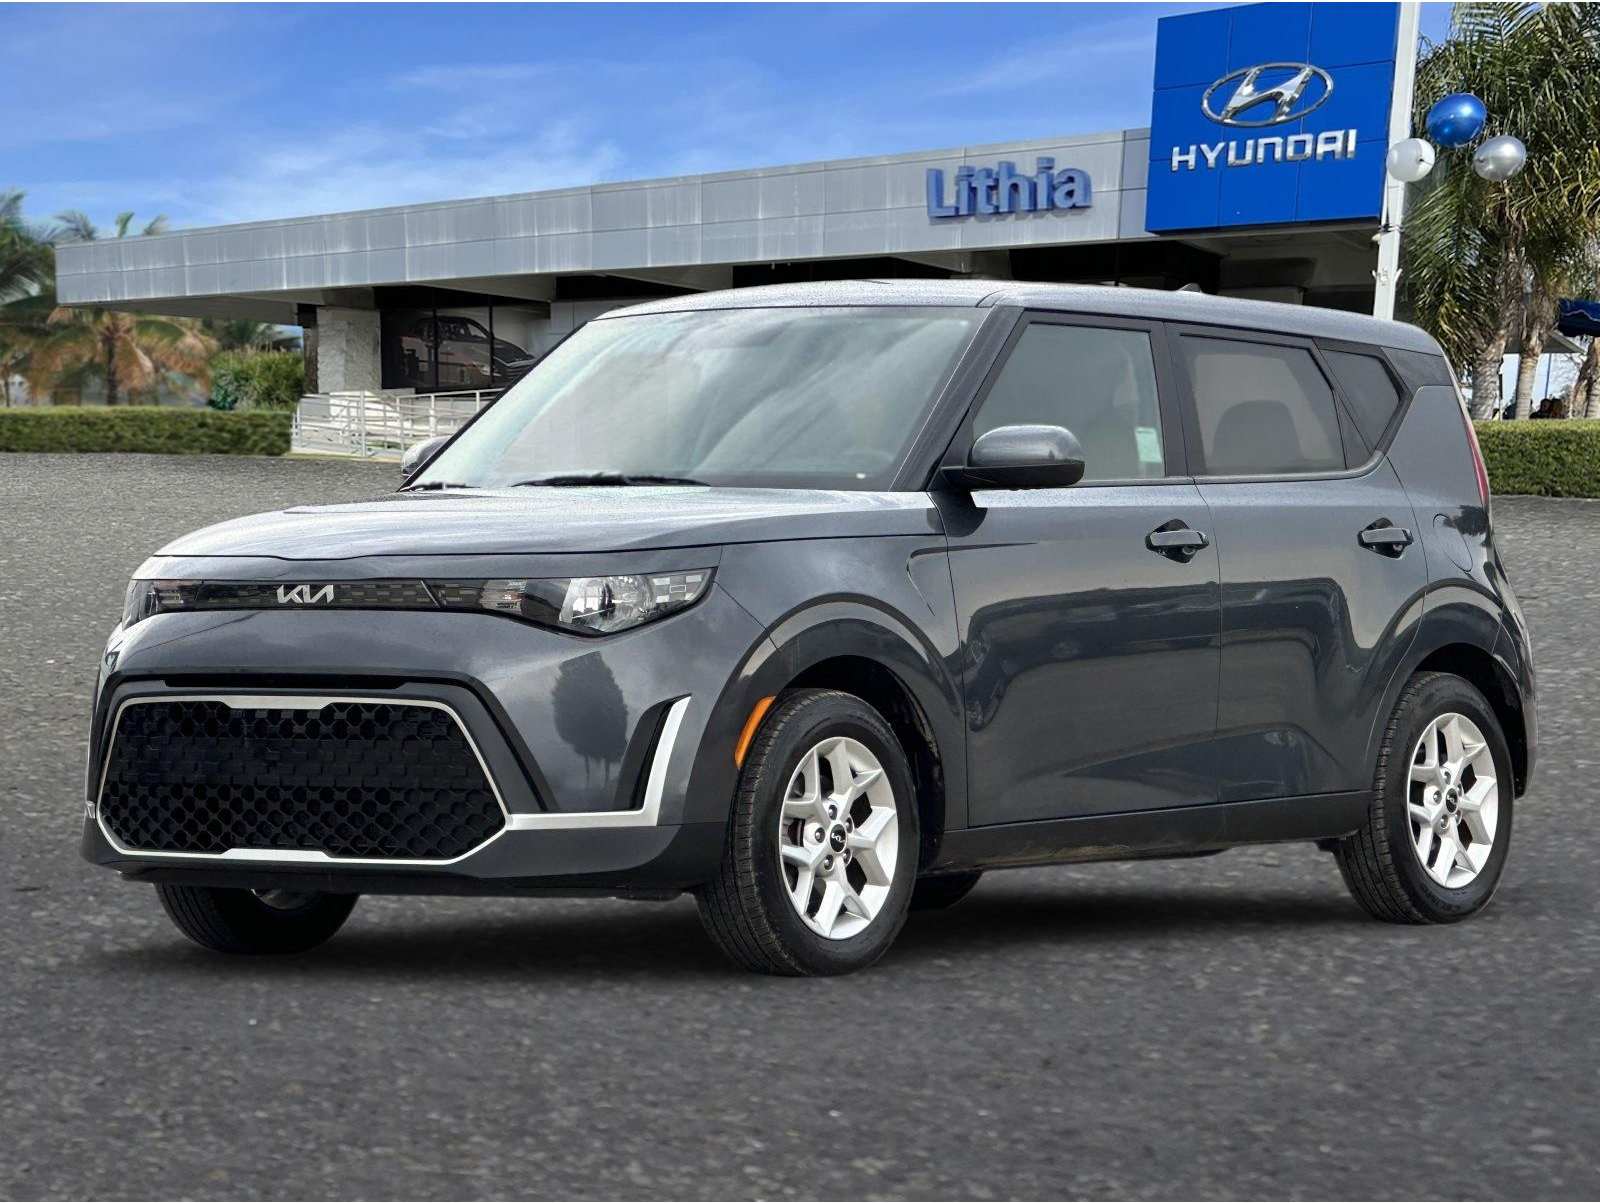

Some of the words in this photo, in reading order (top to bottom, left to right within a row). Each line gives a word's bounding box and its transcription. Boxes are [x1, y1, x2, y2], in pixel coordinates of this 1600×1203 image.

[1171, 129, 1357, 172] HYUNDAI
[926, 156, 1093, 218] Lithia
[276, 584, 335, 604] KIA
